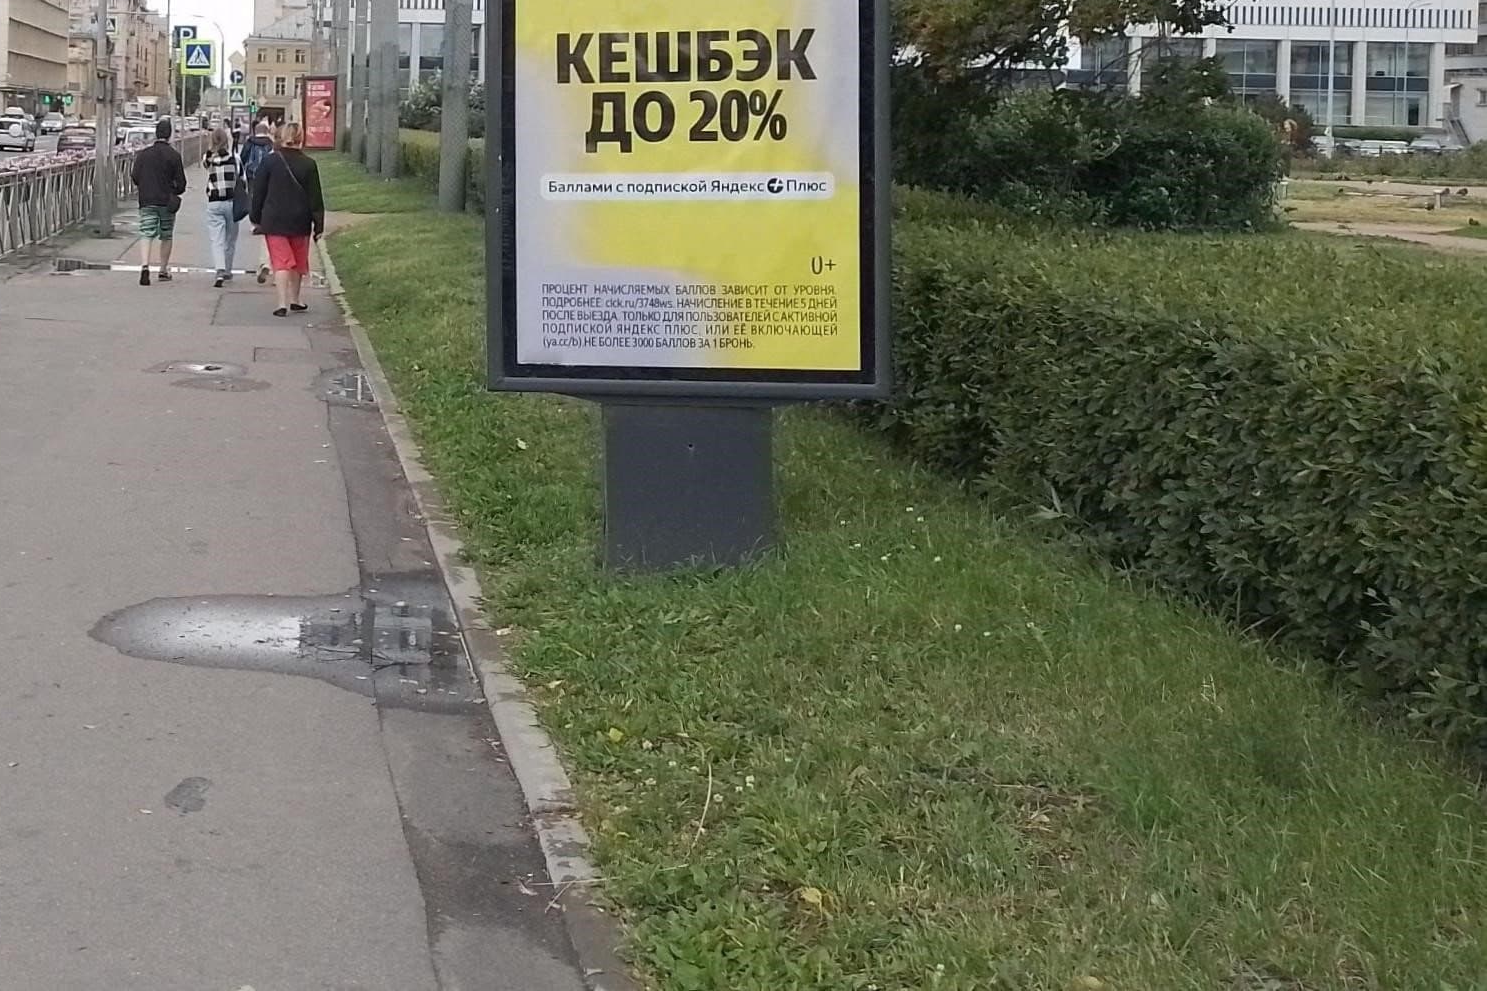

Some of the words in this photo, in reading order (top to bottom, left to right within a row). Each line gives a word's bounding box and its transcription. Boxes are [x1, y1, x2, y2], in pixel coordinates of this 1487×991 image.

[556, 29, 817, 84] КЕШБЭК
[585, 90, 676, 153] ДО
[688, 89, 788, 142] 20%
[548, 180, 612, 193] Баллами
[616, 183, 623, 193] с
[627, 179, 707, 195] подпиской
[710, 180, 764, 194] Яндекс
[786, 179, 826, 192] Плюс
[811, 255, 836, 275] 0+
[542, 283, 588, 296] ПРОЦЕНТ
[594, 284, 670, 296] НАЧИСЛЯЕМЫХ
[675, 285, 716, 296] БАЛЛОВ
[722, 284, 768, 296] ЗАВИСИТ
[774, 284, 788, 296] ОТ
[676, 298, 743, 309] НАЧИСЛЕНИЕ
[754, 298, 800, 309] ТЕЧЕНИЕ
[808, 296, 837, 310] ДНЕЙ
[542, 310, 575, 321] ПОСЛЕ
[621, 311, 661, 322] ТОЛЬКО
[662, 311, 684, 323] ДЛЯ
[685, 310, 771, 323] ПОЛЬЗОВАТЕЛЕЙ
[780, 309, 838, 323] АКТИВНОЙ
[542, 322, 612, 336] ПОДПИСКОЙ
[616, 324, 660, 336] ЯНДЕКС
[705, 324, 729, 336] ИЛИ
[734, 323, 746, 336] ЕЁ
[751, 322, 838, 337] ВКЛЮЧАЮЩЕЙ
[584, 337, 596, 348] НЕ
[598, 337, 631, 348] БОЛЕЕ
[633, 338, 653, 348] 3000
[655, 338, 696, 349] БАЛЛОВ
[698, 338, 710, 348] ЗА
